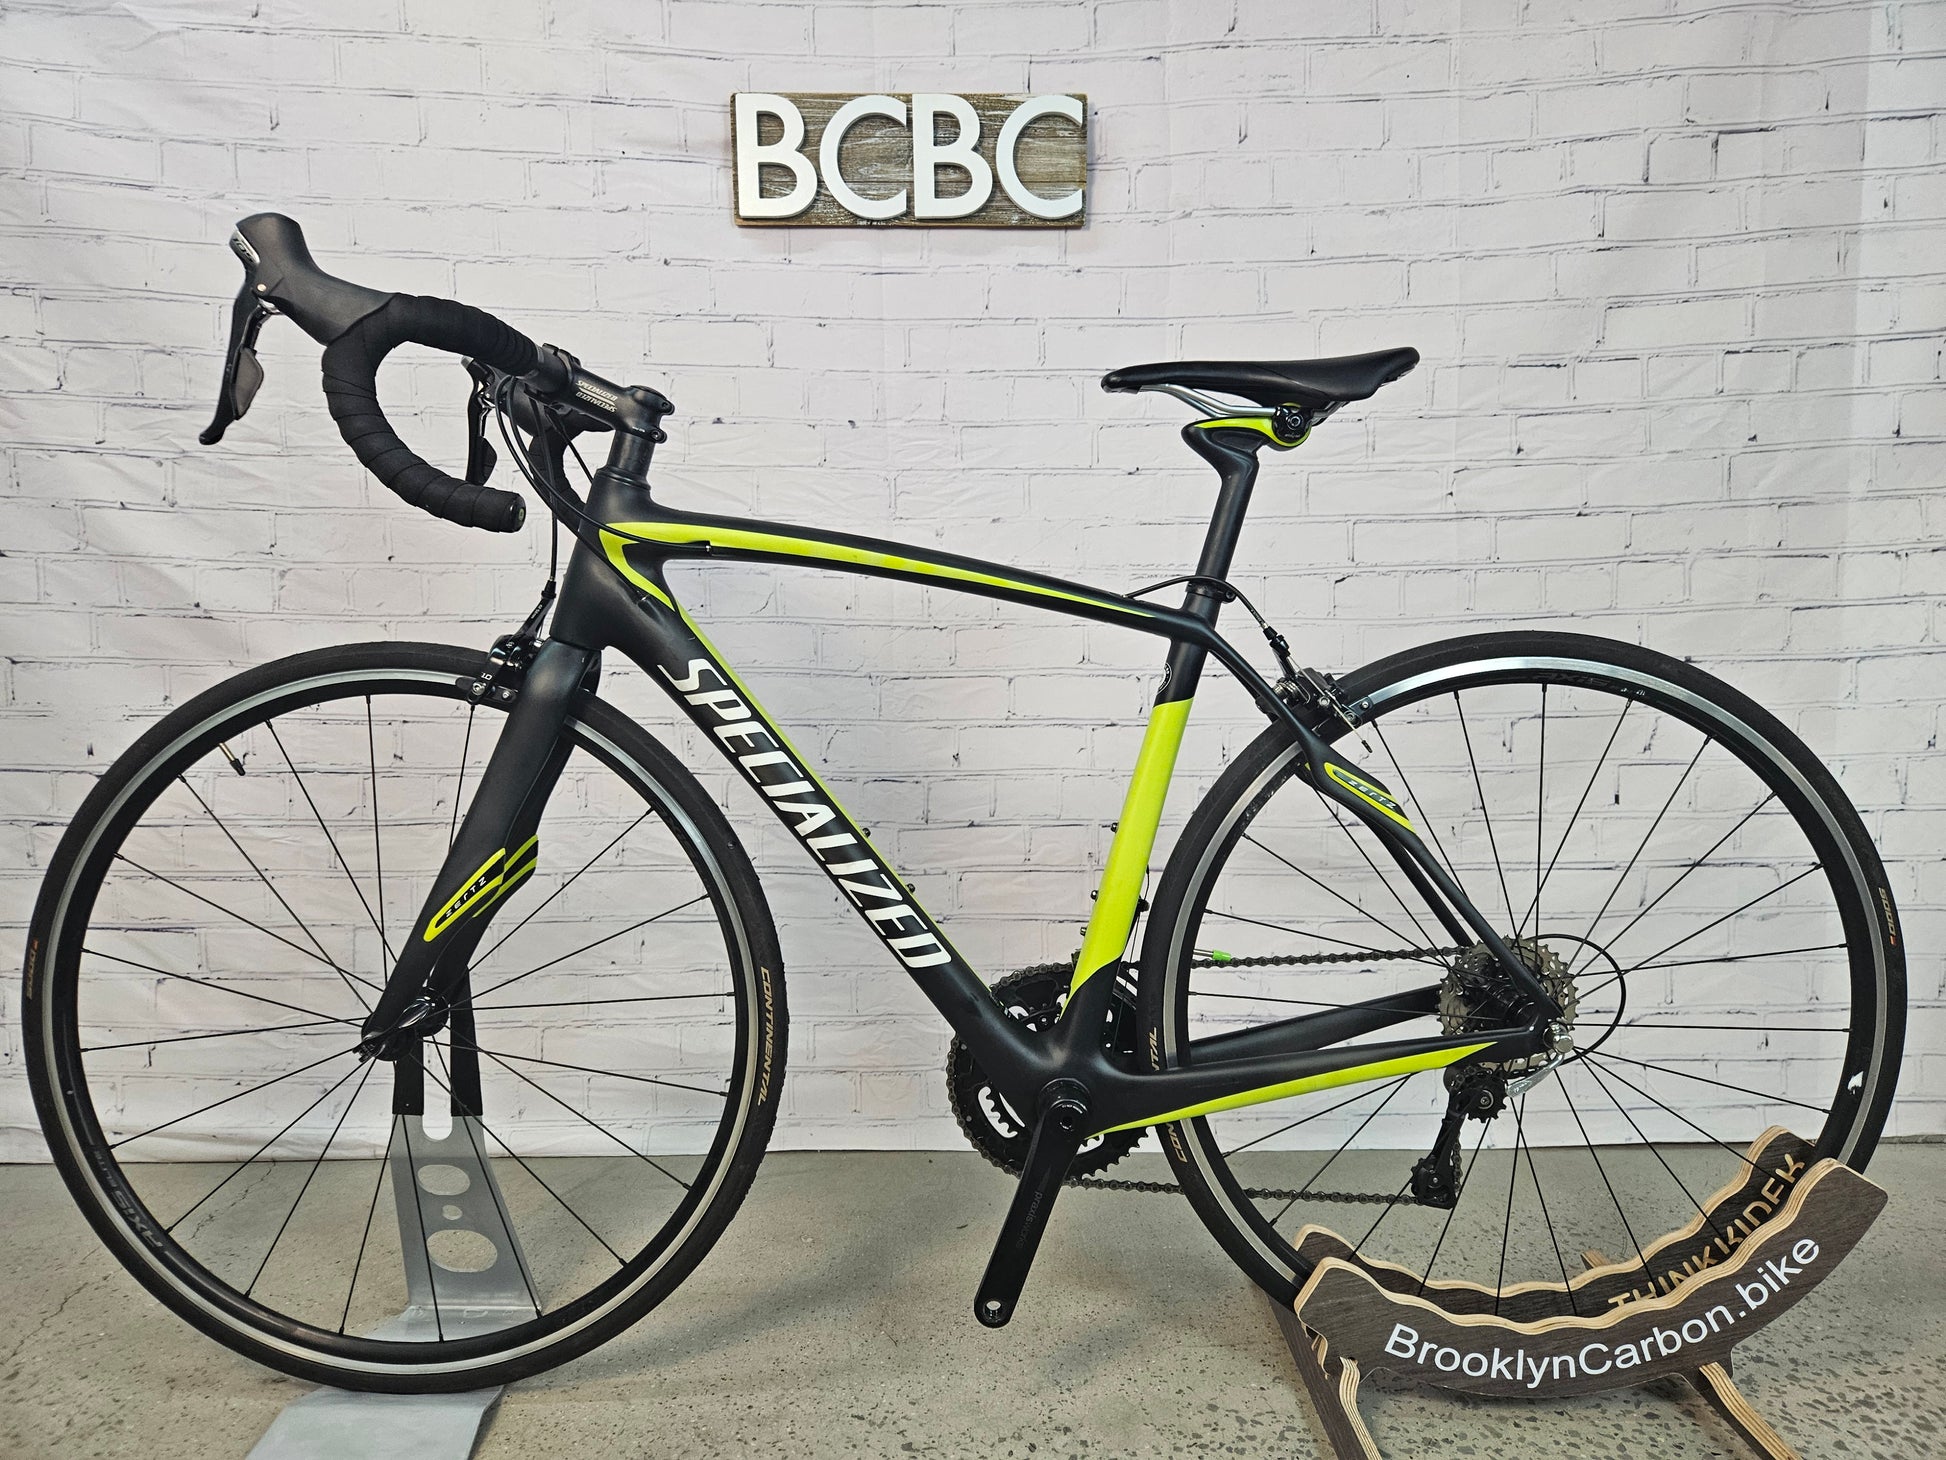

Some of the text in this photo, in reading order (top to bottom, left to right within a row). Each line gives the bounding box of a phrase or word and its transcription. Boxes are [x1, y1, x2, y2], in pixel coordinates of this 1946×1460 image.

[735, 93, 1083, 220] BCBC
[576, 380, 618, 401] SPECIALIZED
[657, 658, 952, 970] SPECIALIZED
[757, 966, 774, 1107] CONTINENTAL
[1384, 1238, 1820, 1389] BrooklynCarbon.bike
